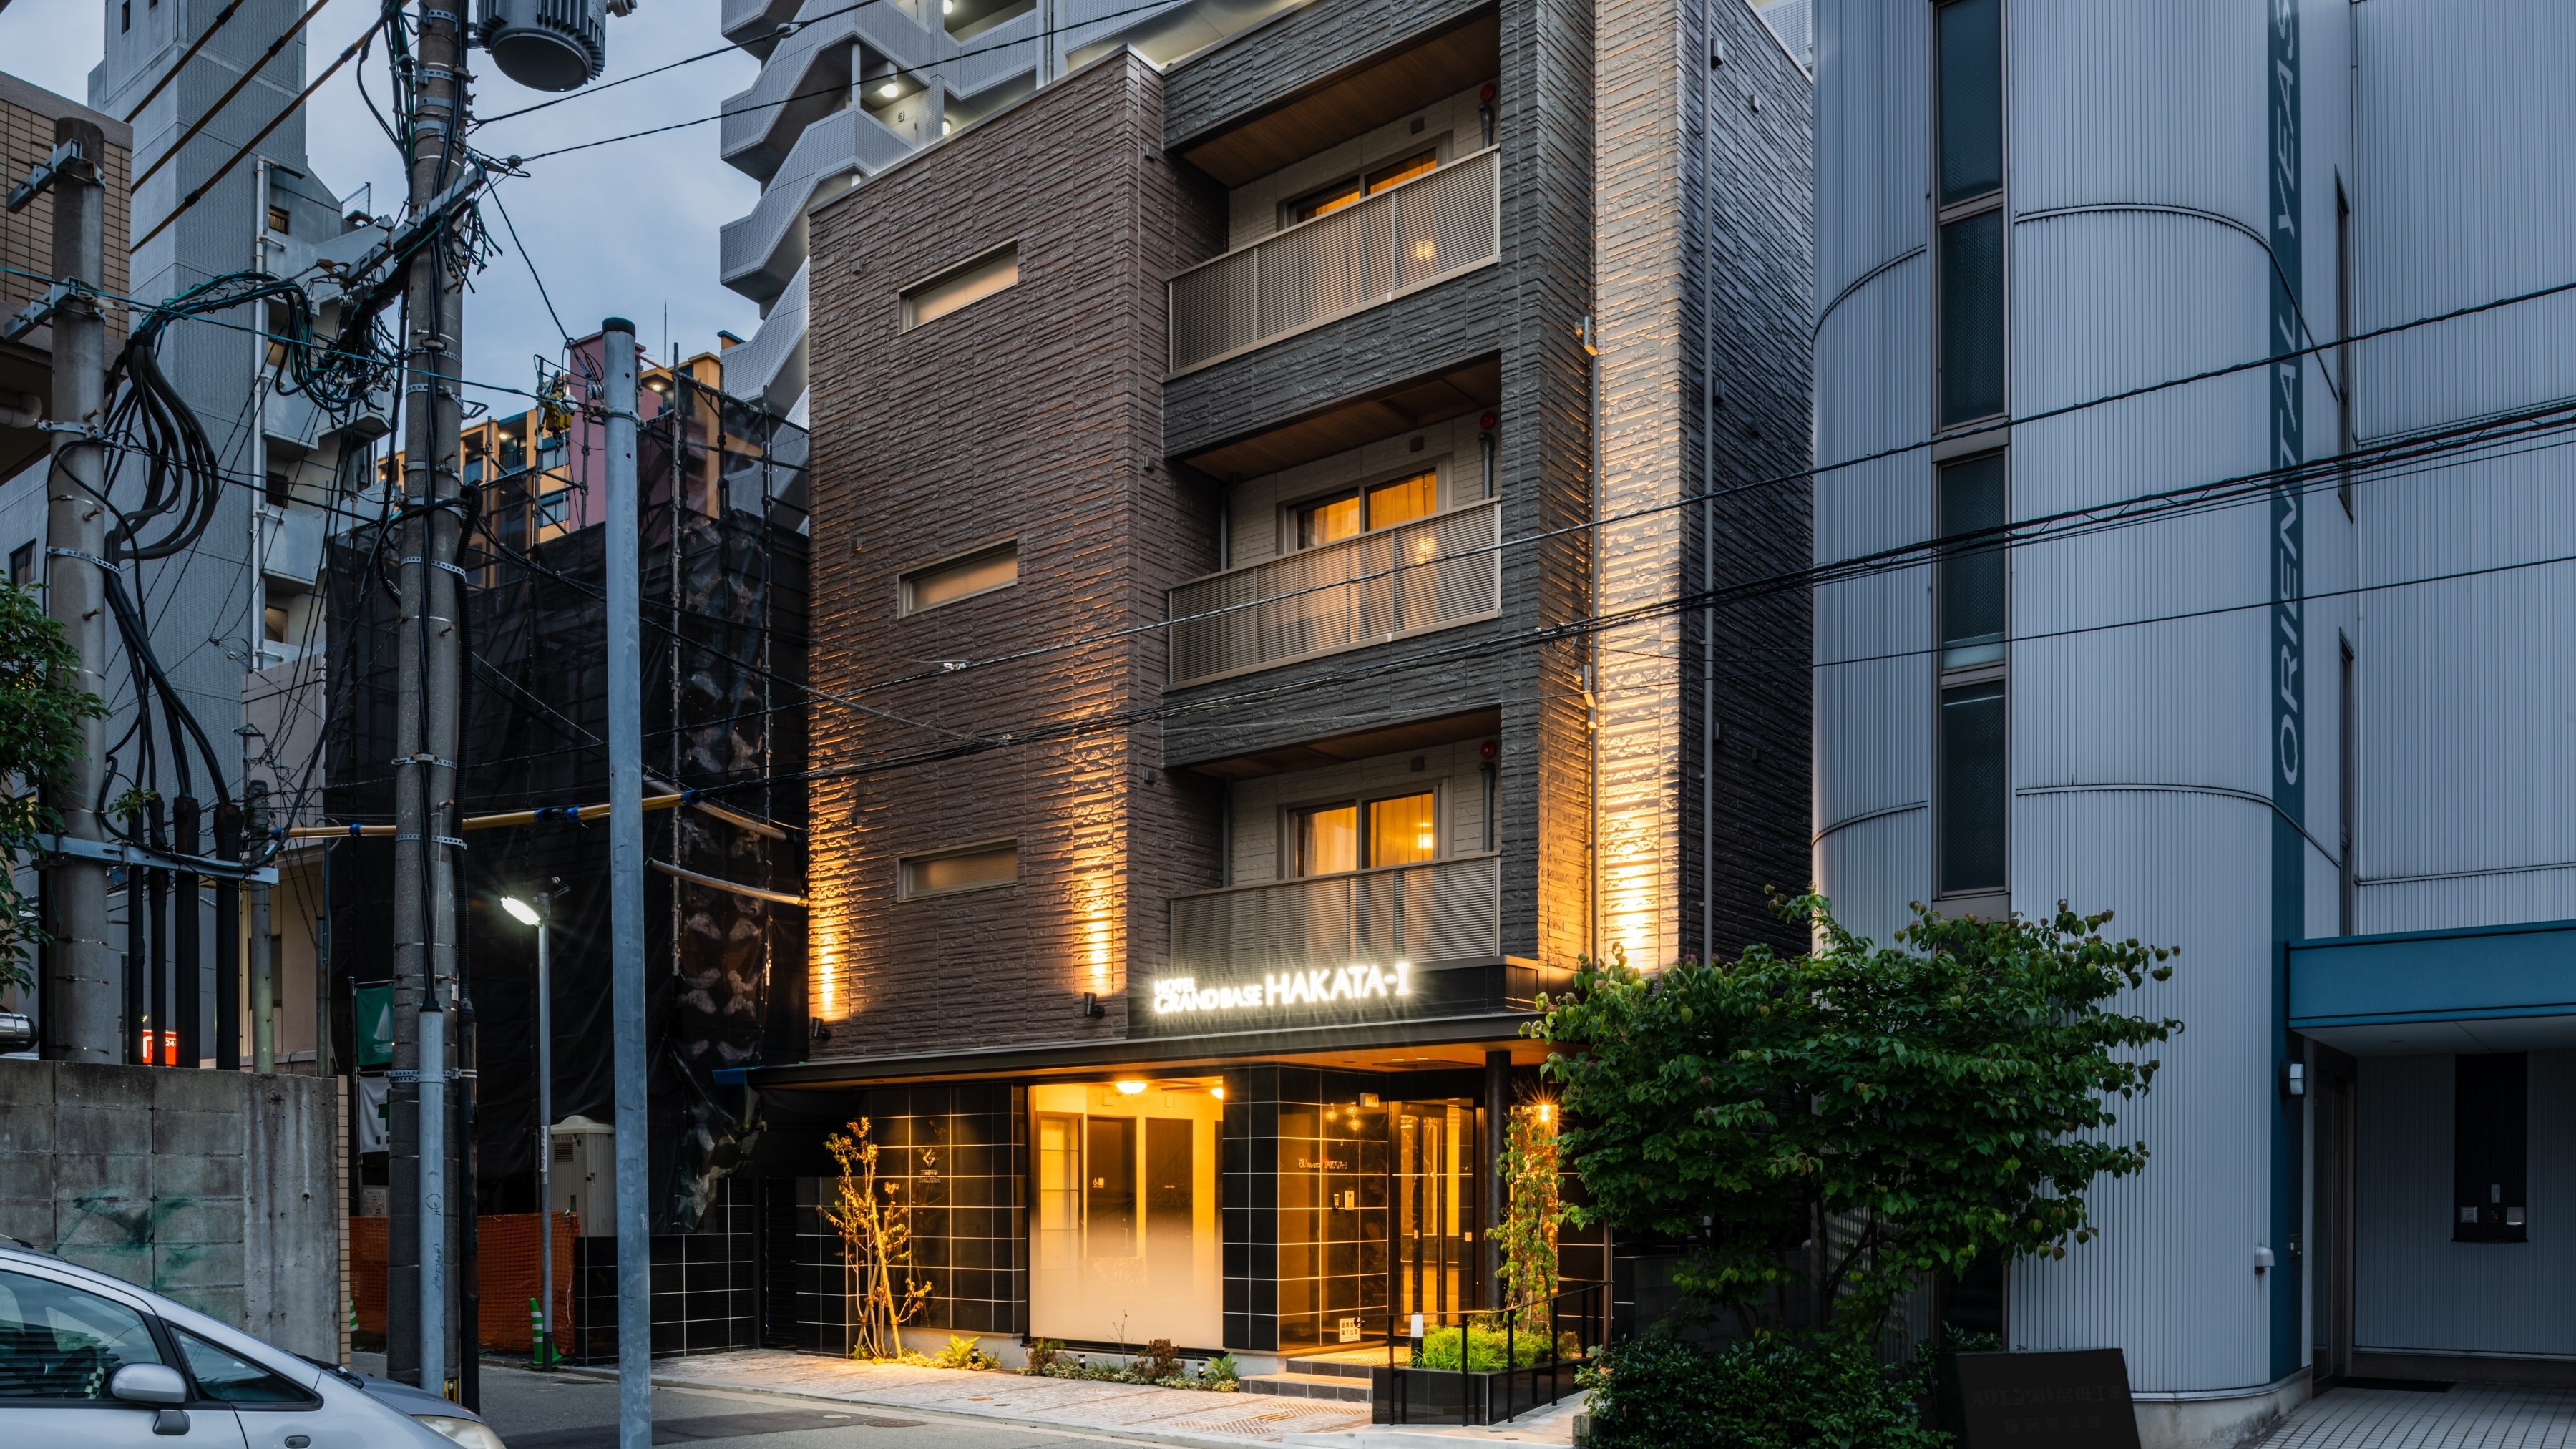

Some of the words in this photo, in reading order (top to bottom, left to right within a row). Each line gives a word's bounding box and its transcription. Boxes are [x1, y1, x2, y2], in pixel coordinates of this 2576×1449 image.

[2279, 303, 2298, 785] ORIENTAL
[1154, 977, 1197, 995] HOTEL
[1265, 962, 1410, 1005] HAKATA-I
[1969, 1385, 2124, 1407] オリエンタル酵母工業
[2004, 1414, 2102, 1434] 福岡営業部
